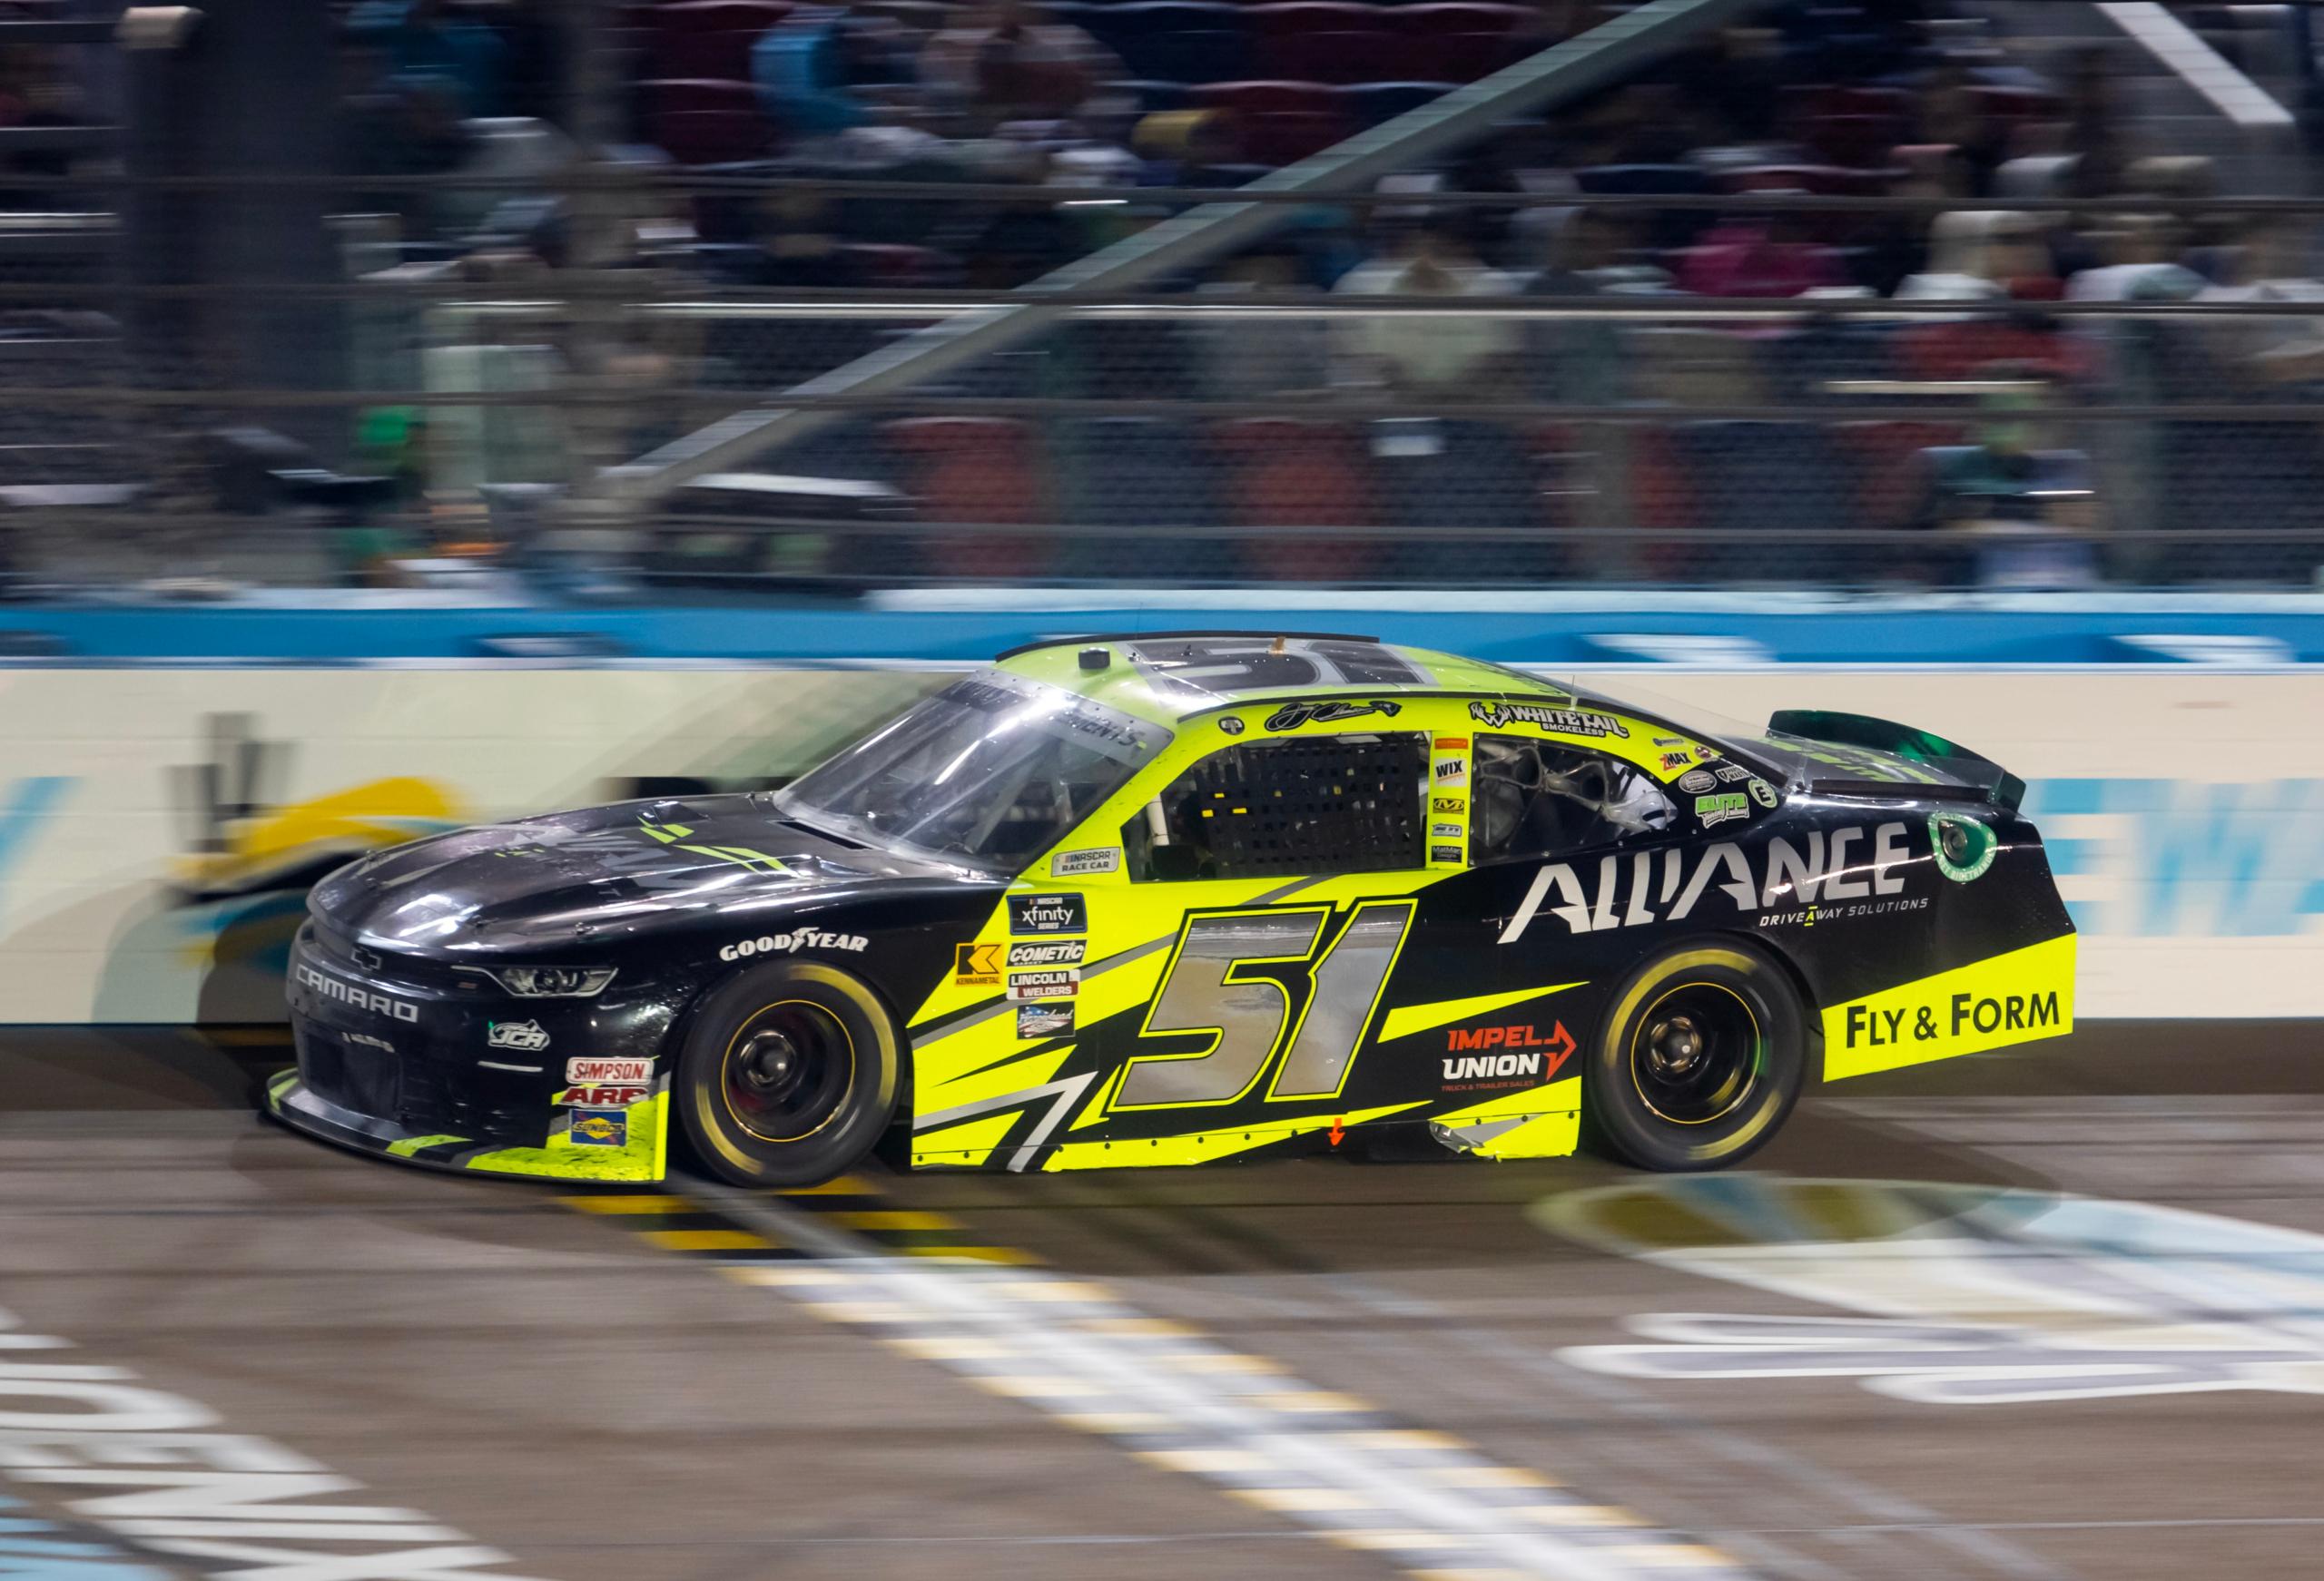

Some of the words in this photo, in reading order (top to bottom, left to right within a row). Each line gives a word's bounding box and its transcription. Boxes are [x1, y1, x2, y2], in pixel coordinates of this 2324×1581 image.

[1511, 705, 1630, 738] WHITETAIL
[1542, 722, 1605, 737] SMOKELESS
[1436, 761, 1462, 777] WIX
[1072, 850, 1111, 862] NASCAR
[1062, 863, 1087, 871] RACE
[1089, 861, 1109, 869] CAR
[1497, 821, 1910, 945] ALLIANCE
[1021, 906, 1074, 926] xfinity
[1759, 906, 1844, 928] DRIVEAWAY
[1847, 898, 1929, 917] SOLUTIONS
[956, 977, 1000, 985] KENNAMETAL
[1010, 972, 1068, 986] LINCOLN
[296, 963, 419, 1023] CAMARO
[1022, 986, 1072, 997] WELDERS
[1107, 899, 1418, 1113] 51
[1914, 1006, 1938, 1041] &
[1447, 1025, 1543, 1051] IMPEL
[575, 1063, 645, 1080] SIMPSON
[1442, 1053, 1541, 1080] UNION
[1442, 1085, 1467, 1093] TRUCK
[1475, 1081, 1508, 1090] TRAILER
[1509, 1079, 1534, 1088] SALES
[573, 1122, 625, 1134] SUNOCO
